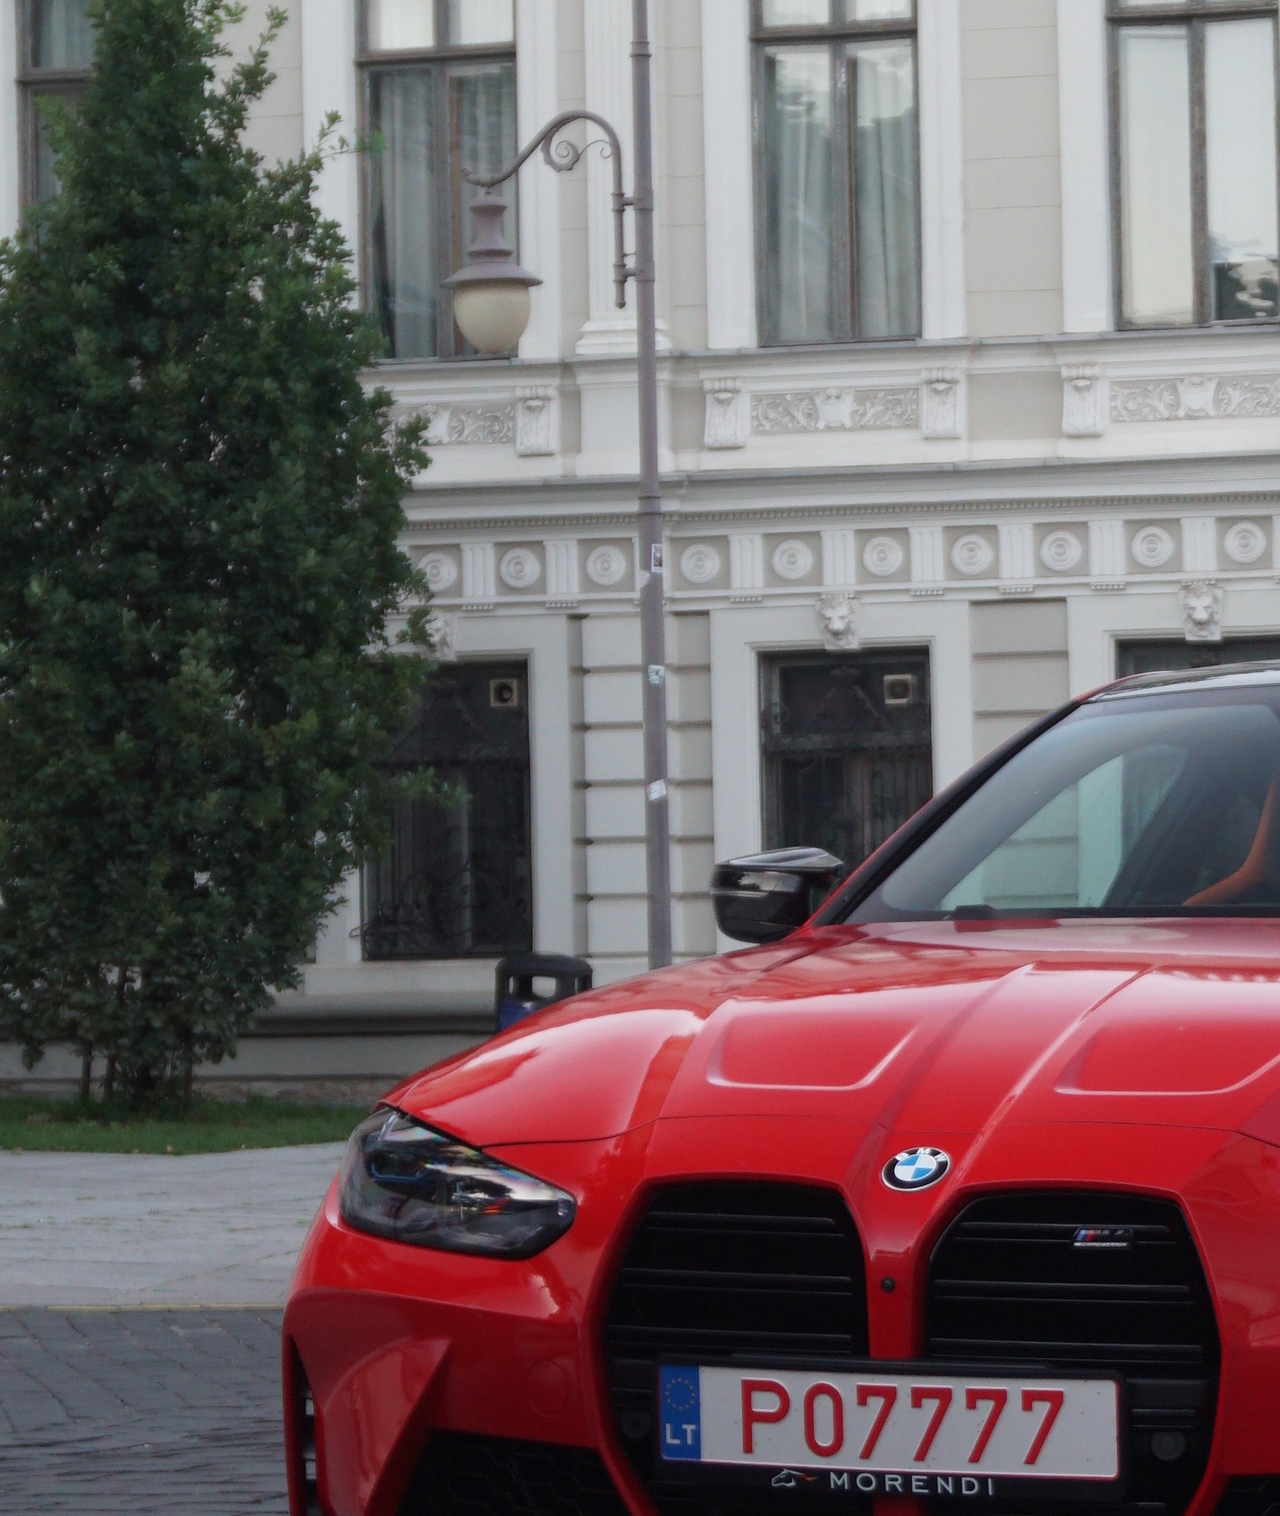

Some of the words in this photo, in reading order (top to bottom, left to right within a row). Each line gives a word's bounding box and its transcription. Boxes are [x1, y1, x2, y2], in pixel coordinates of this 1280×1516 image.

[894, 1147, 947, 1162] BMW
[740, 1378, 1066, 1465] P07777
[665, 1423, 697, 1448] LT
[829, 1471, 996, 1497] MORENDI
